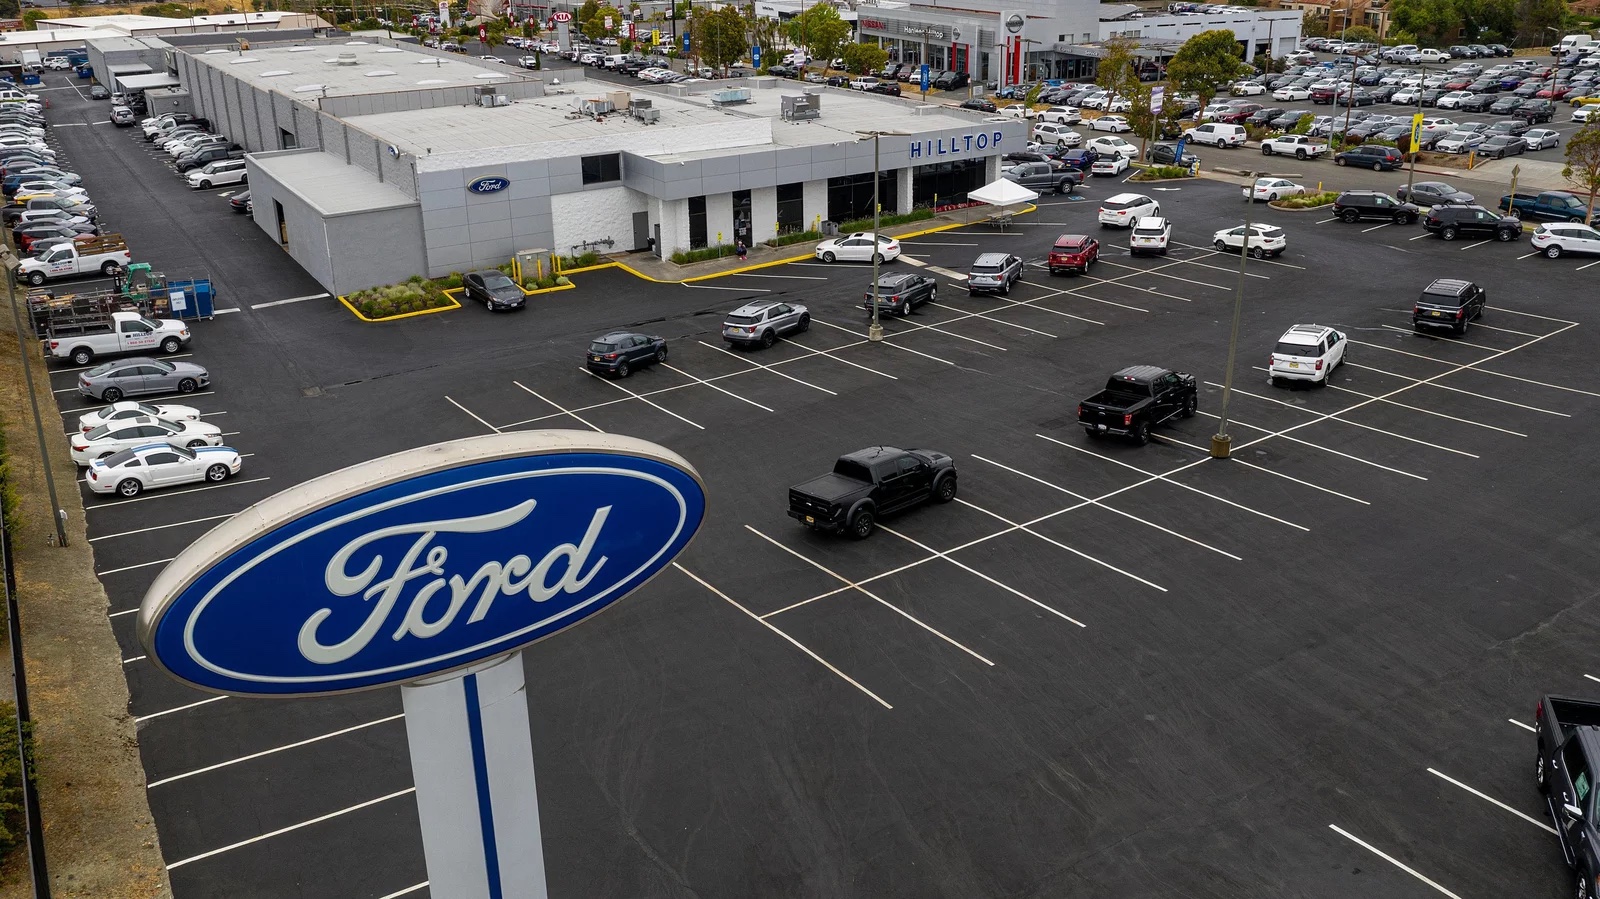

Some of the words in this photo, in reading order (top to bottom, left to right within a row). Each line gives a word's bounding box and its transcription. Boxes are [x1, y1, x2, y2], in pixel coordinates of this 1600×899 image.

[862, 19, 886, 30] NISSAN
[910, 131, 1003, 159] HILLTOP
[479, 180, 502, 191] Ford
[298, 498, 613, 664] Ford
